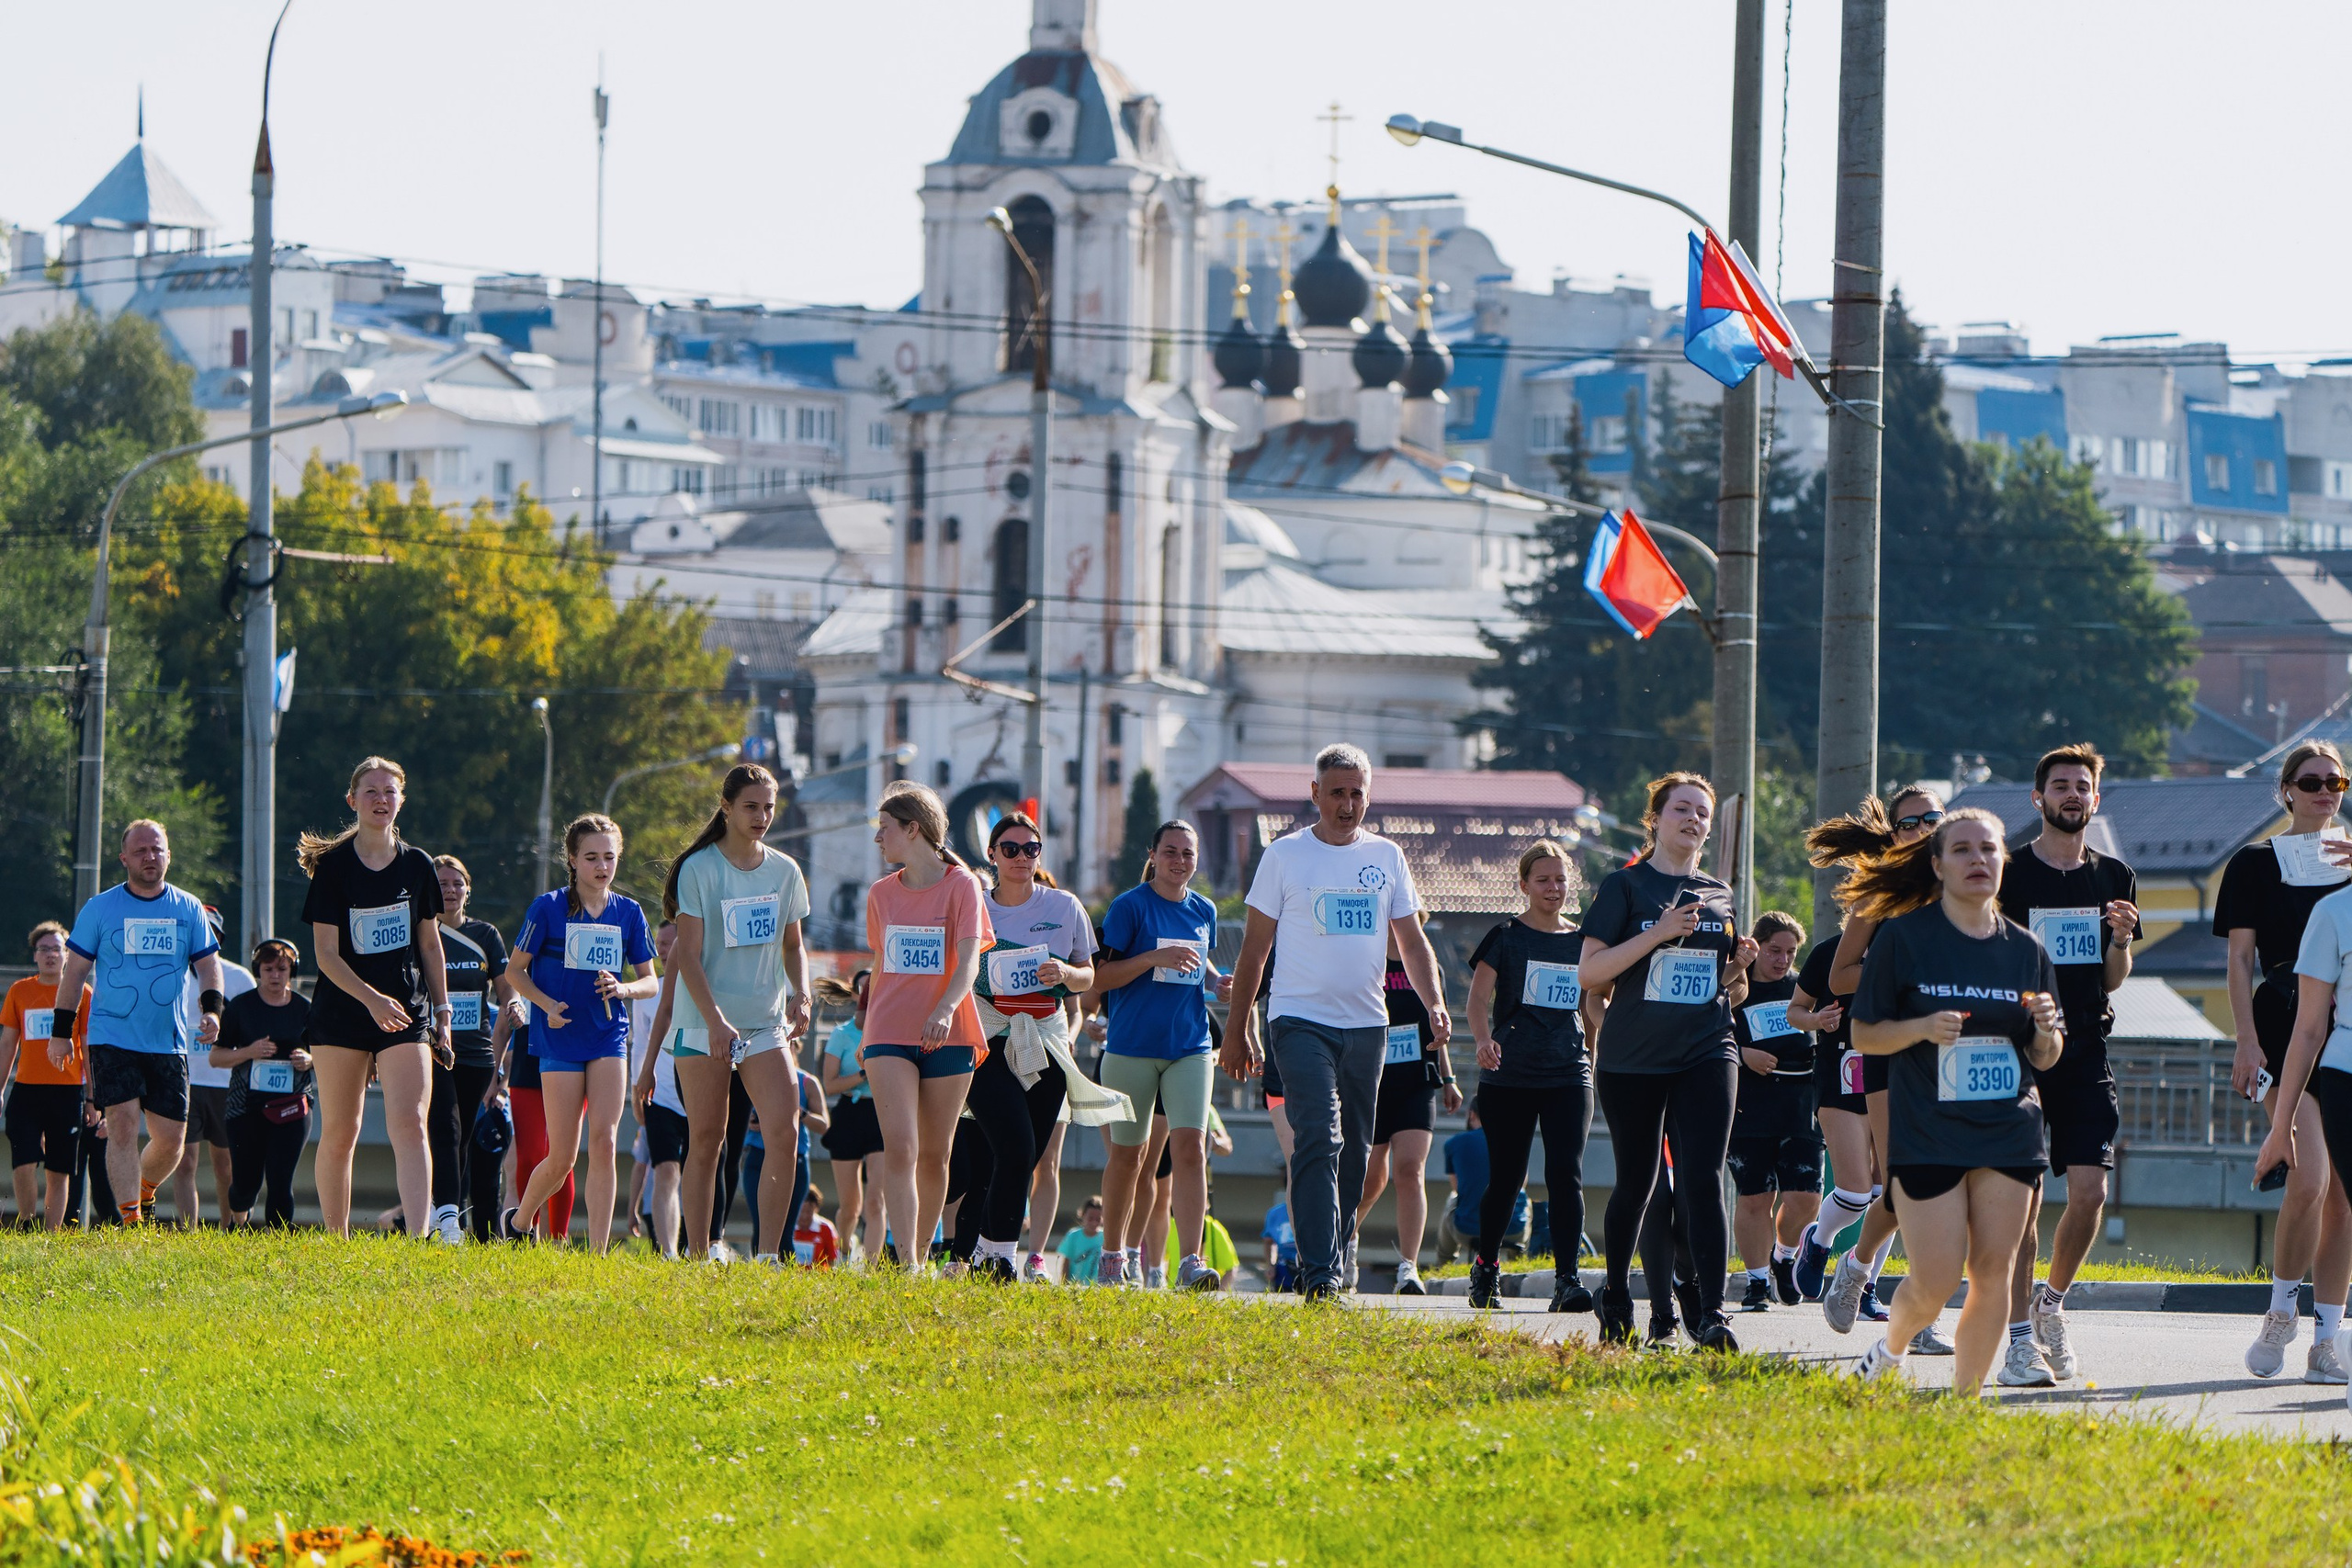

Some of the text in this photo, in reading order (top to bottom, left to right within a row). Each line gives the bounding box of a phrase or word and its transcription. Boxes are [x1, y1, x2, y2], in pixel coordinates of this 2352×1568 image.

[1337, 897, 1369, 908] ТИМОФЕЙ
[751, 907, 771, 917] МАРИЯ
[378, 915, 401, 927] ПОЛИНА
[1336, 909, 1373, 930] 1313
[146, 927, 167, 935] АНДРЕЙ
[746, 917, 775, 939] 1254
[2062, 922, 2090, 933] КИРИЛЛ
[142, 936, 173, 950] 2746
[372, 925, 406, 947] 3085
[595, 936, 614, 945] МАРИЯ
[900, 938, 941, 948] АЛЕКСАНДРА
[2055, 934, 2097, 957] 3149
[586, 946, 618, 966] 4951
[903, 949, 940, 968] 3454
[1016, 958, 1038, 969] ИРИНА
[1673, 962, 1711, 974] АНАСТАСИЯ
[1010, 968, 1044, 989] 338
[1555, 975, 1571, 984] АННА
[1671, 975, 1712, 998] 3767
[1547, 985, 1577, 1004] 1753
[1390, 1042, 1414, 1059] 714
[1970, 1052, 2009, 1064] ВИКТОРИЯ
[267, 1075, 288, 1089] 407
[1967, 1066, 2015, 1092] 3390
